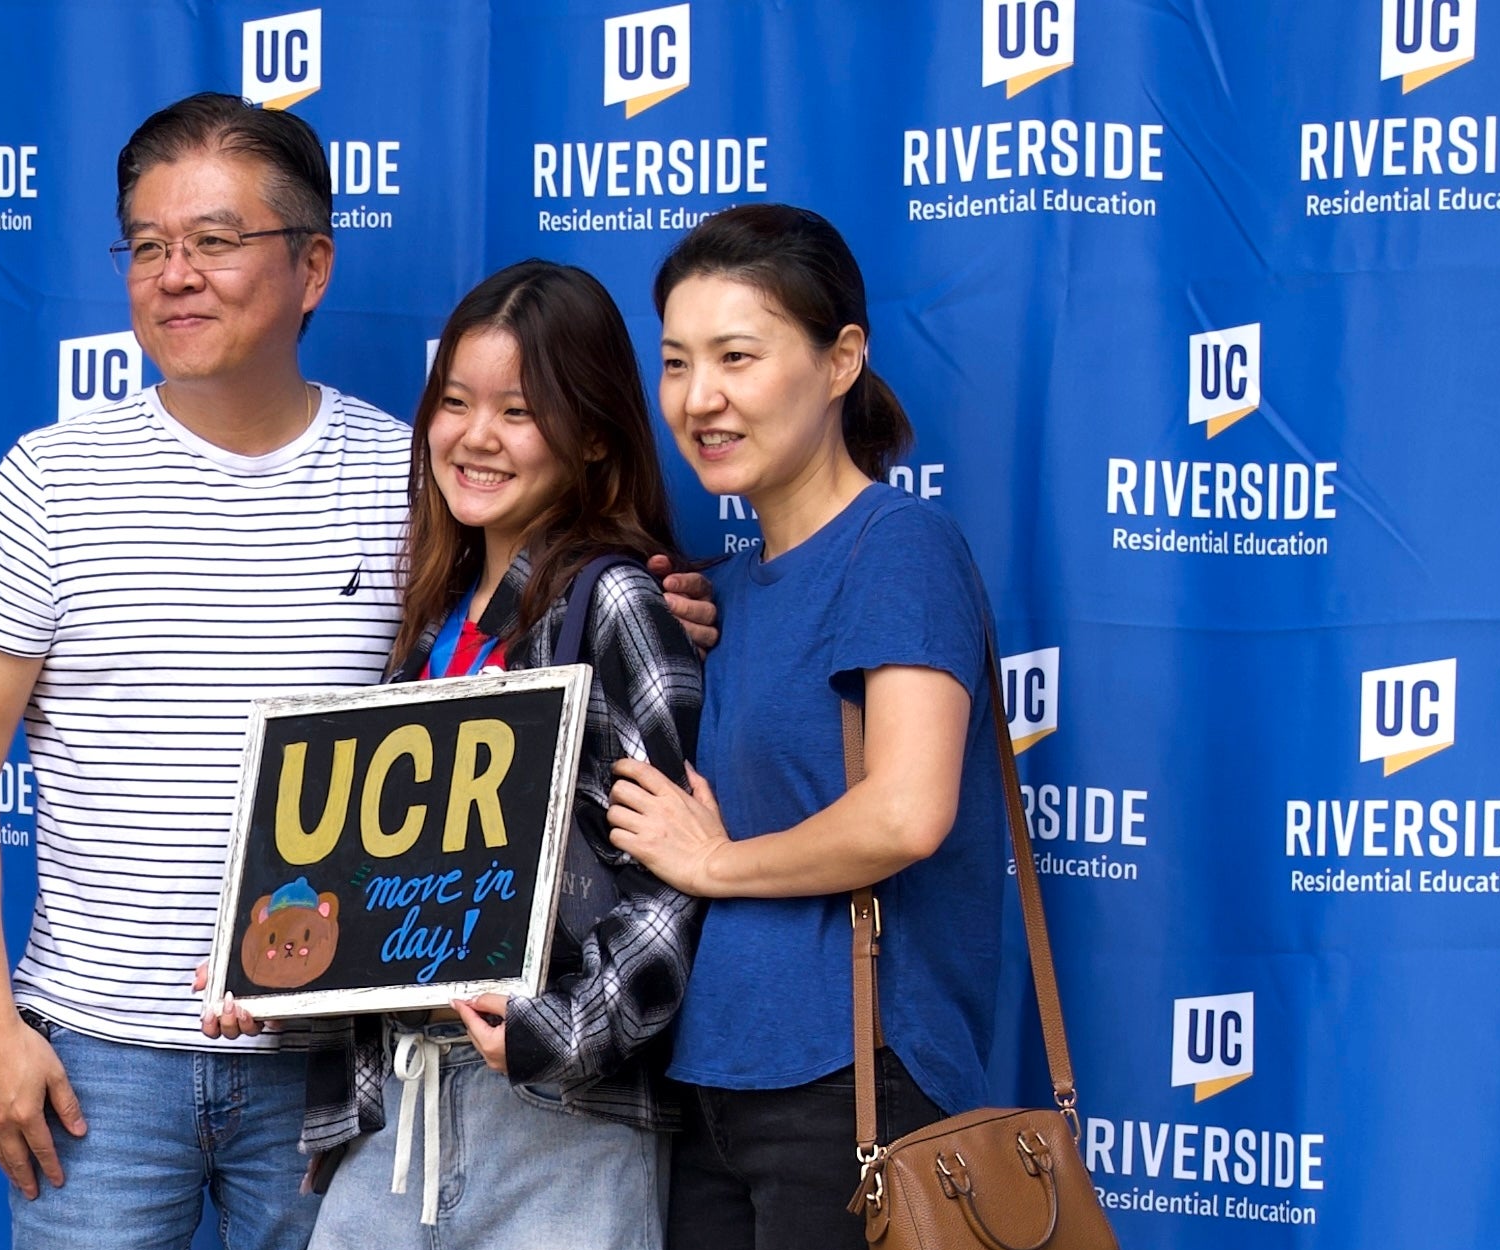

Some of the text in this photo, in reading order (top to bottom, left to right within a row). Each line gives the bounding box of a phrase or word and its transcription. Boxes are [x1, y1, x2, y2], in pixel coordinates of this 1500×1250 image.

[618, 24, 677, 81] UC
[998, 0, 1059, 60] UC
[1395, 0, 1460, 54] UC
[255, 28, 309, 84] UC
[535, 138, 767, 197] RIVERSIDE
[904, 119, 1163, 185] RIVERSIDE
[331, 206, 392, 228] cation
[540, 207, 653, 231] Residential
[910, 188, 1155, 220] Residential Education
[1307, 187, 1430, 216] Residential
[71, 348, 129, 402] UC
[1200, 343, 1248, 401] UC
[1108, 458, 1337, 519] RIVERSIDE
[1113, 528, 1327, 555] Residential Education
[1376, 679, 1440, 737] UC
[274, 718, 516, 866] UCR
[365, 859, 516, 912] move in
[1292, 868, 1412, 892] Residential
[380, 905, 481, 984] day!
[1187, 1008, 1242, 1067] UC
[1086, 1118, 1324, 1190] RIVERSIDE
[1095, 1187, 1315, 1224] Residential Education
